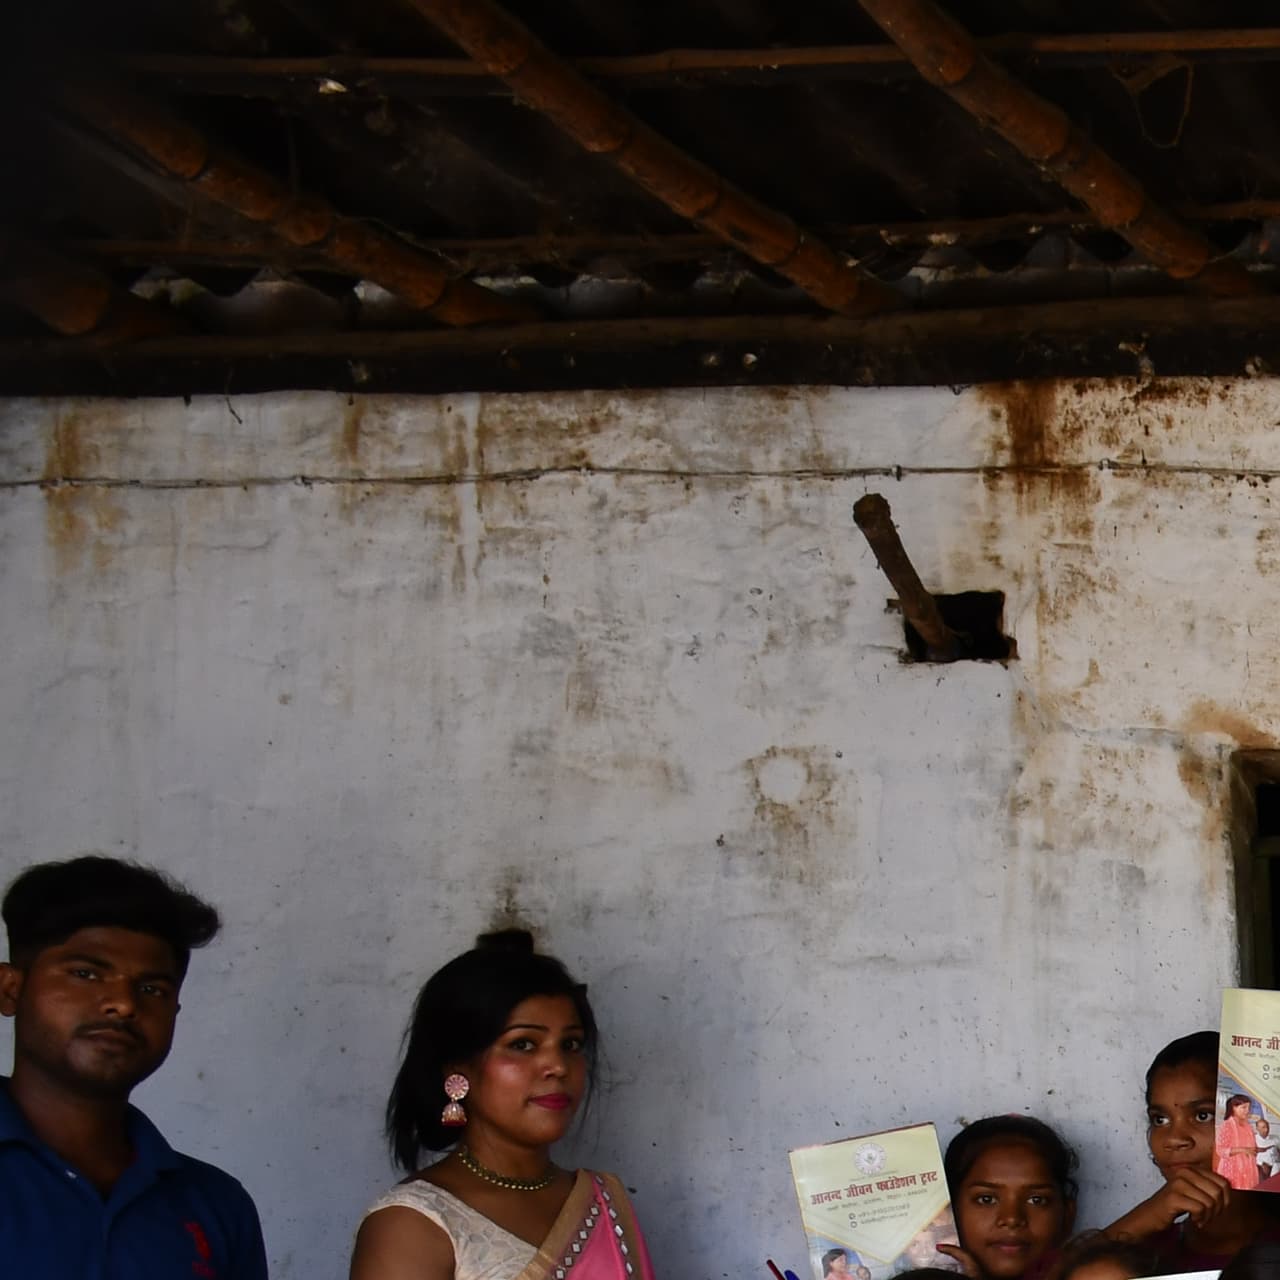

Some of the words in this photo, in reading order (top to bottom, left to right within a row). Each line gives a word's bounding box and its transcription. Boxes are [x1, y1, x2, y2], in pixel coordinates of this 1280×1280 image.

[1230, 1035, 1263, 1049] आनन्द
[810, 1189, 843, 1205] आनन्द
[843, 1183, 874, 1198] जीवन
[875, 1174, 918, 1192] फाउंडेशन
[918, 1170, 938, 1186] ट्रस्ट
